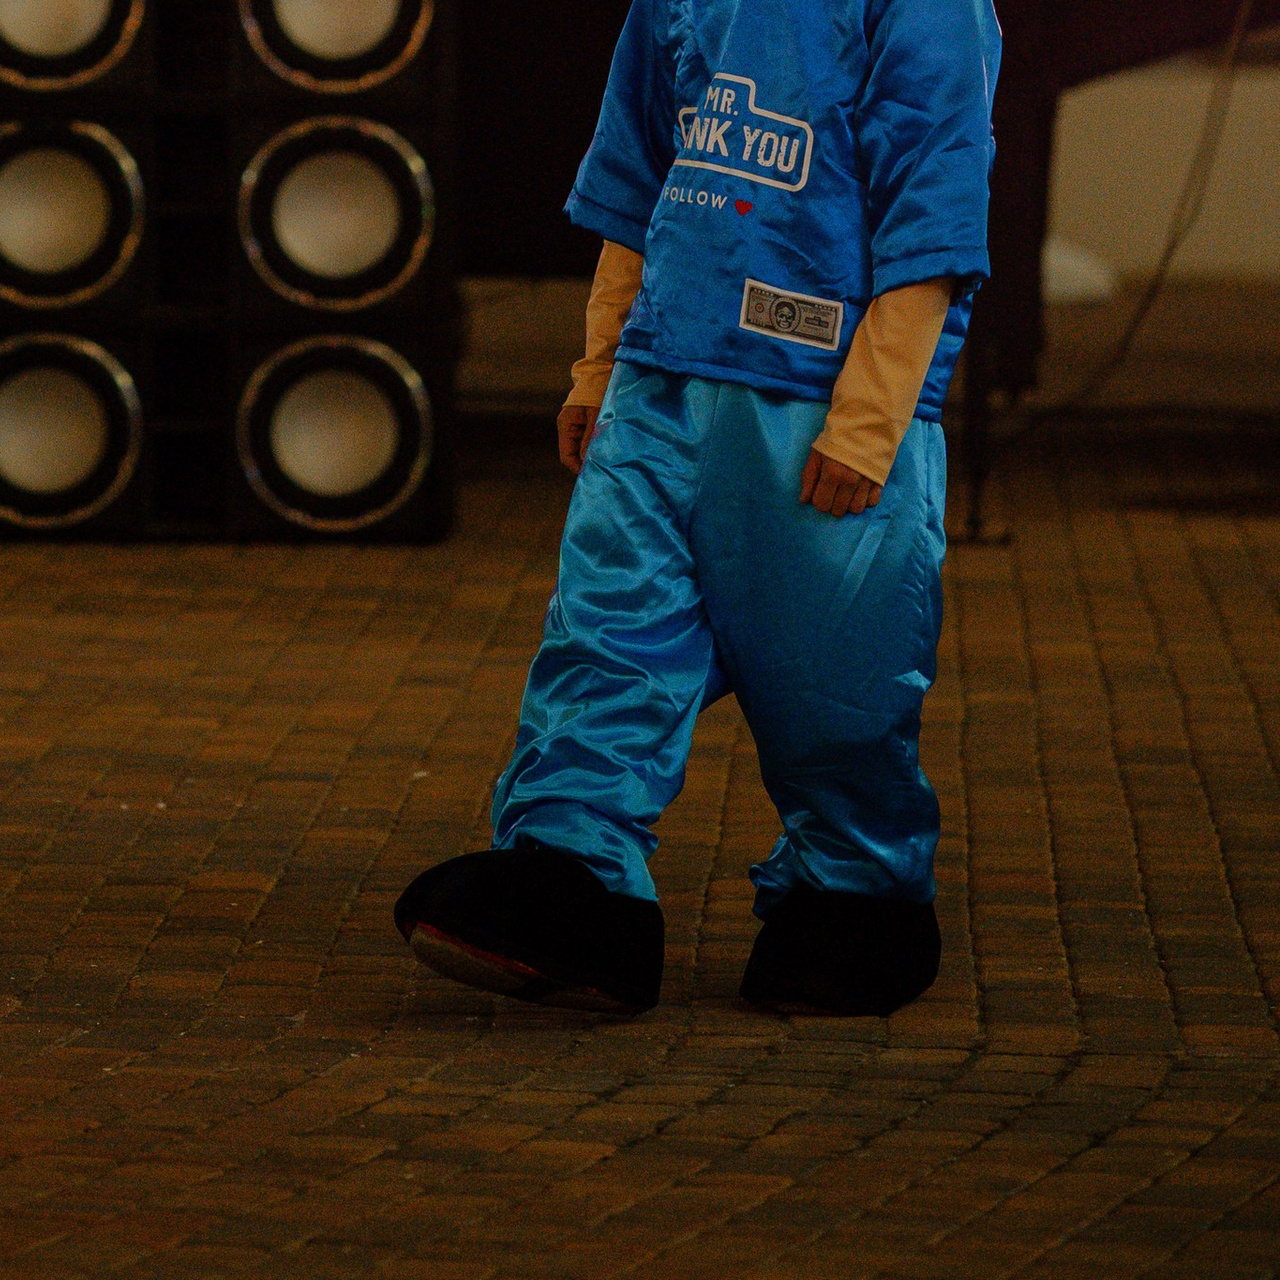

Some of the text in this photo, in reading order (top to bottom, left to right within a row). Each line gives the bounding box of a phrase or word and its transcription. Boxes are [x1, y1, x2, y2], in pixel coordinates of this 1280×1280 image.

[704, 85, 739, 117] MR.
[742, 125, 800, 173] YOU
[663, 186, 728, 210] FOLLOW
